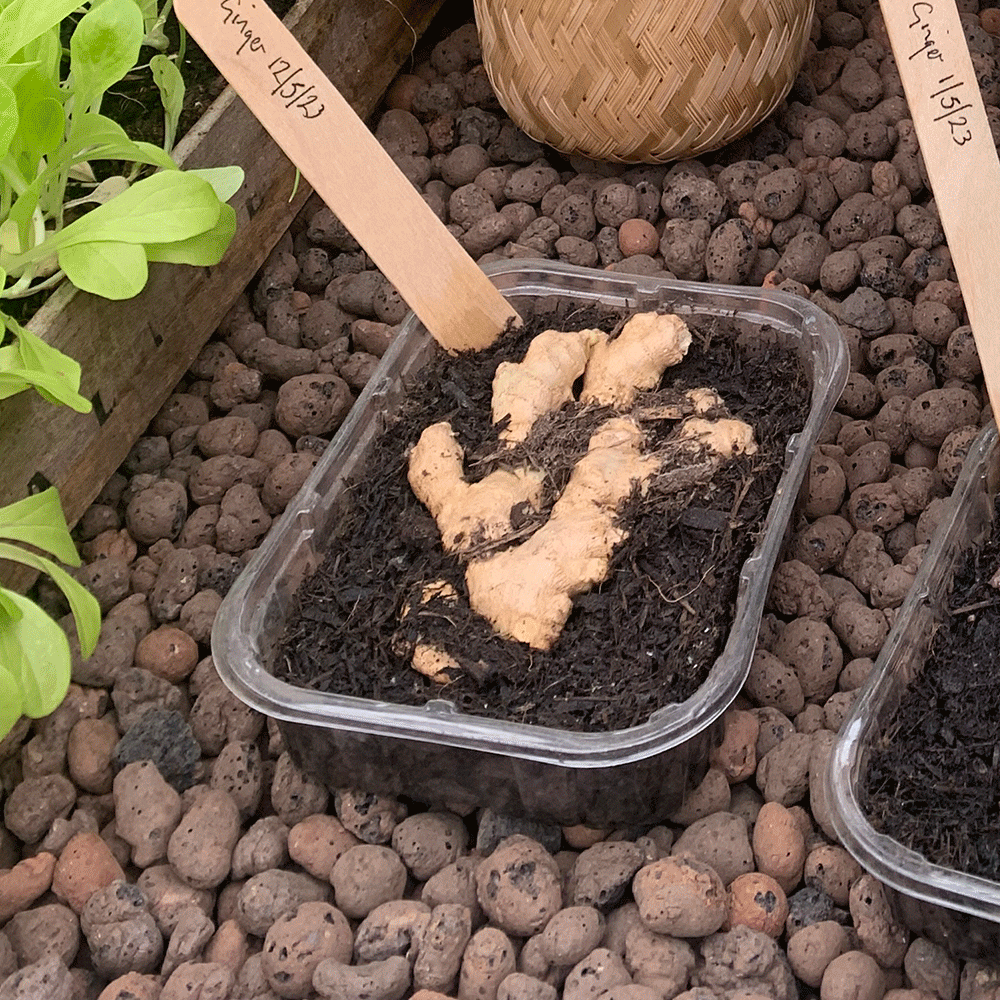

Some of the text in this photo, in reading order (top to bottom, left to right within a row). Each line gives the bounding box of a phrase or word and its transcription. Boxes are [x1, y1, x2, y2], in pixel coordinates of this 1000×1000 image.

[268, 56, 325, 119] 12/5/23
[908, 1, 973, 146] Ginger 1/5/23
